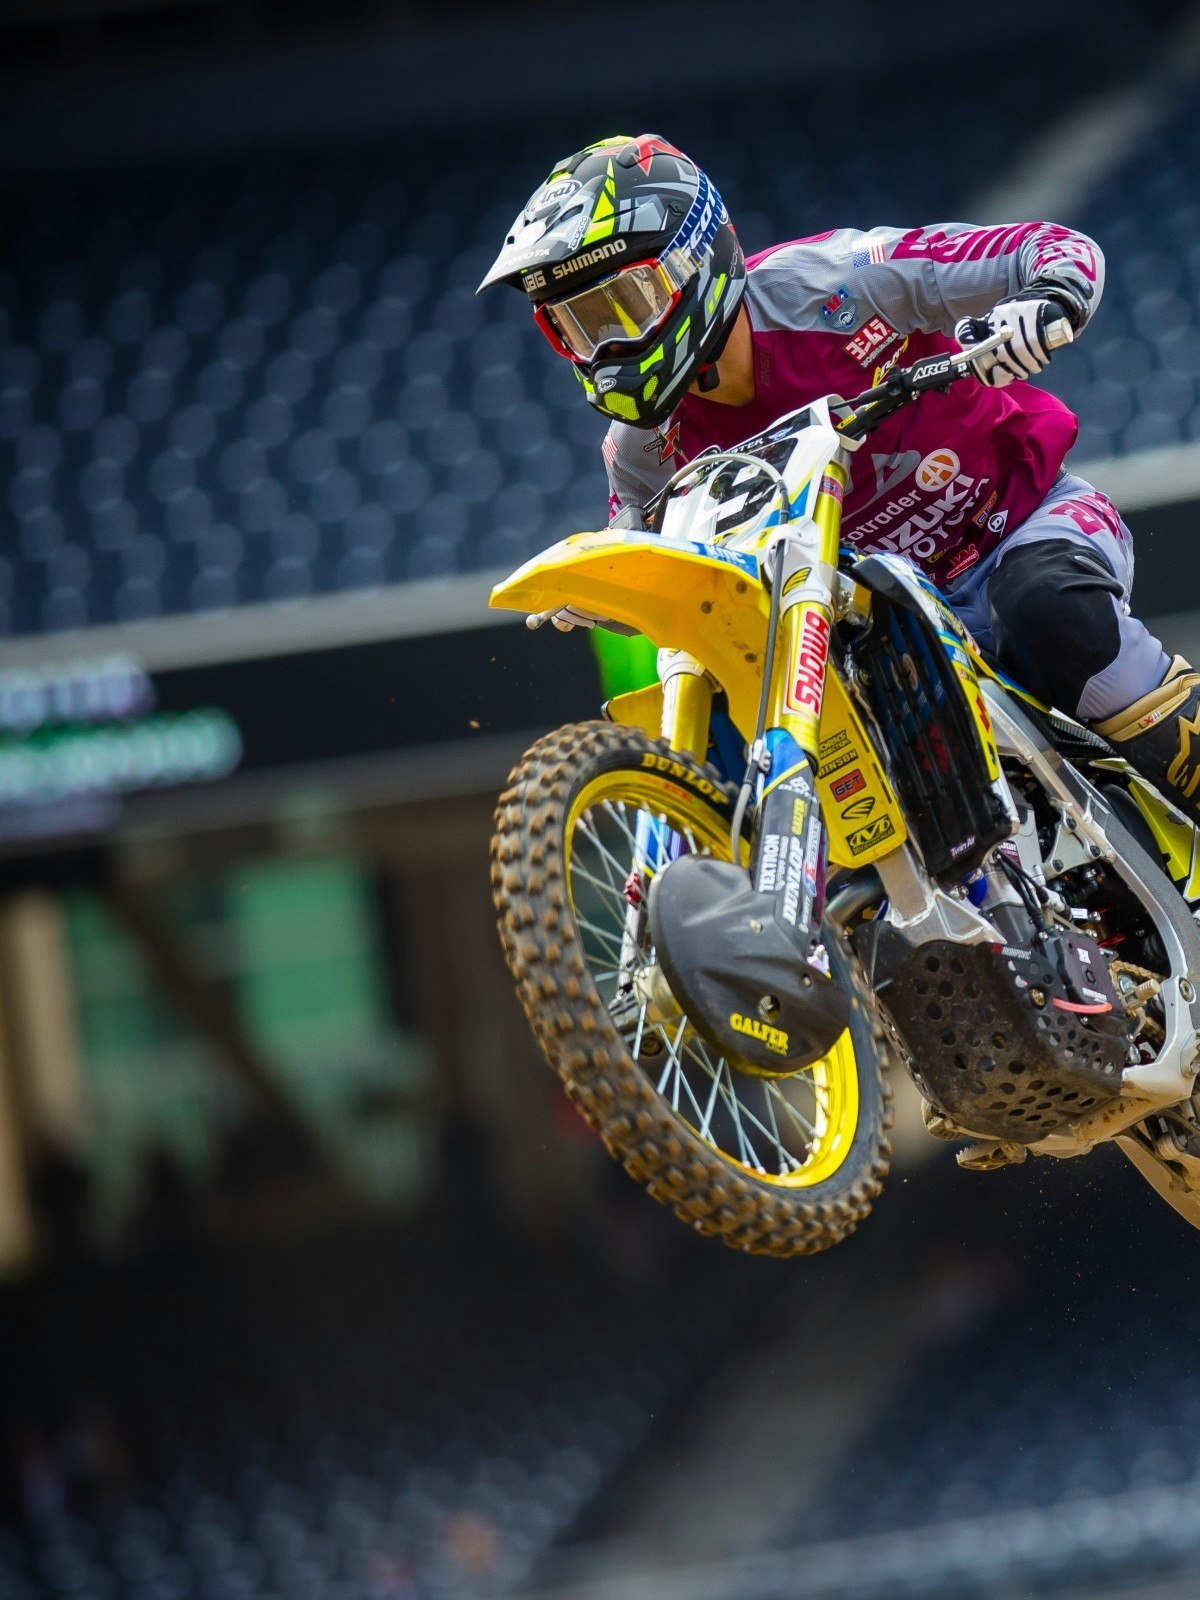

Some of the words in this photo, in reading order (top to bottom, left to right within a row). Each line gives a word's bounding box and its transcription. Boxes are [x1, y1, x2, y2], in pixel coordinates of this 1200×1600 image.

[553, 239, 627, 280] SHIMANO
[912, 360, 951, 382] ARC
[863, 474, 975, 554] UZUKI
[795, 611, 830, 715] SHOWA
[820, 730, 847, 751] ORKS
[642, 752, 730, 805] DUNLOP
[834, 775, 862, 796] GET
[759, 834, 781, 893] TEXTRON
[782, 836, 804, 926] DUNLOP
[730, 1012, 789, 1050] GALFER
